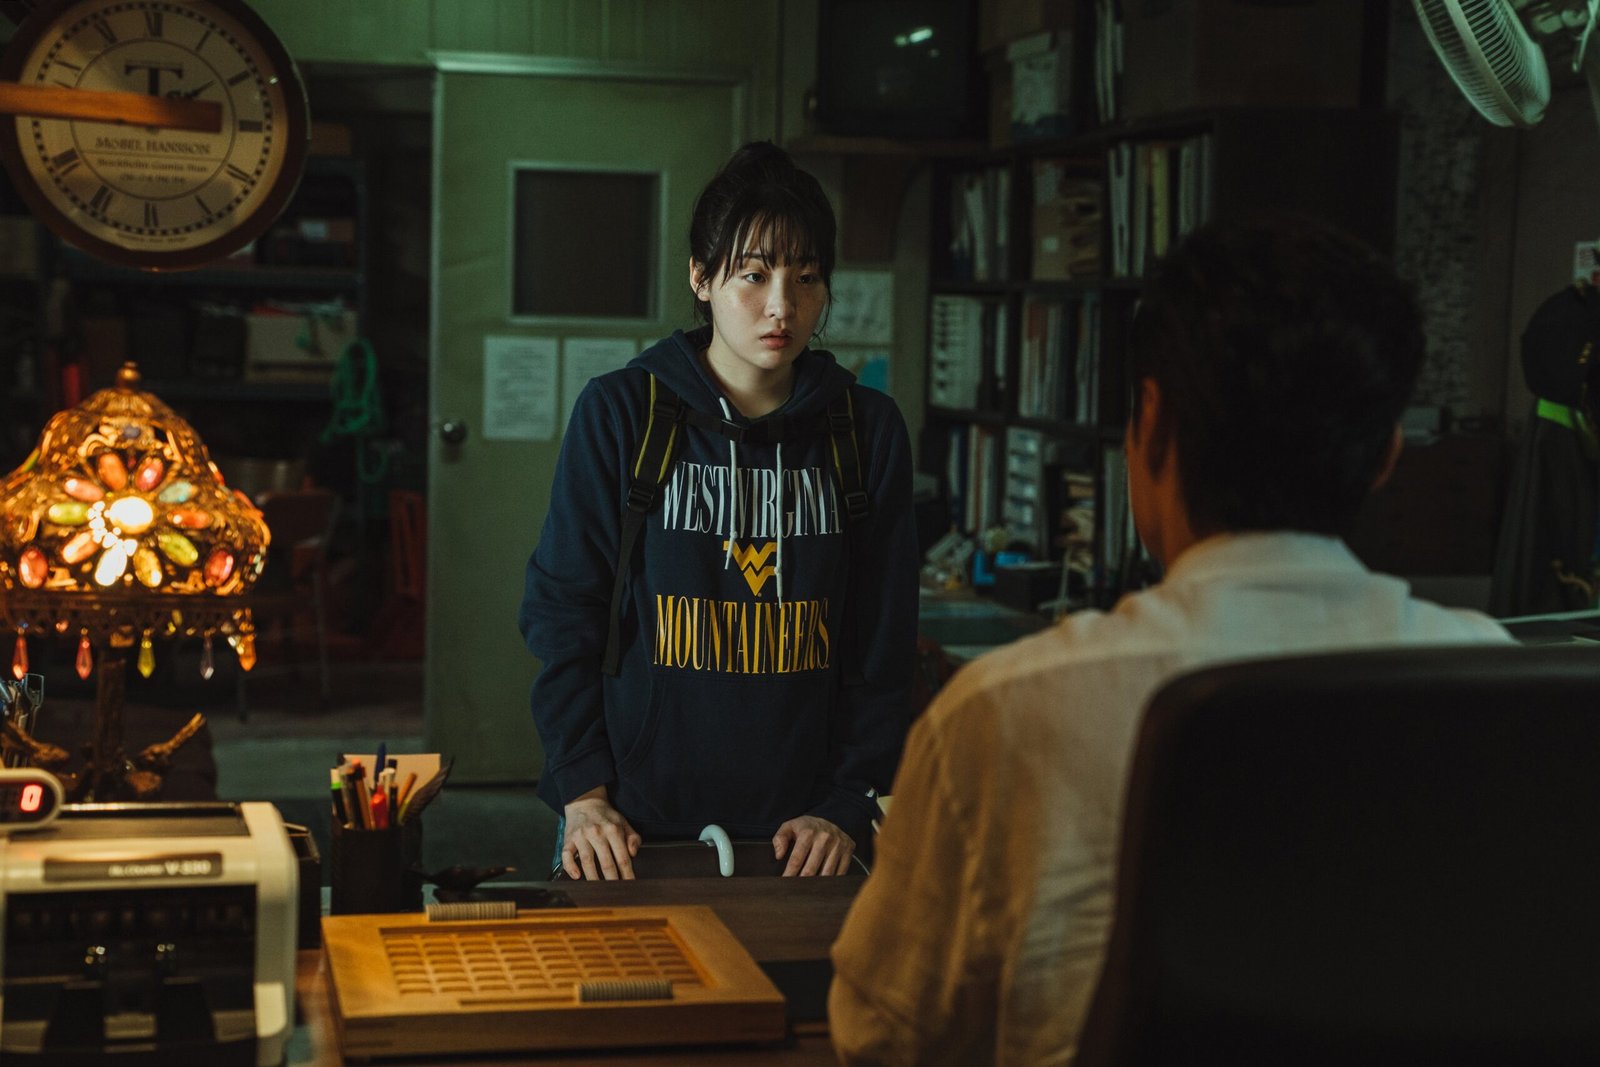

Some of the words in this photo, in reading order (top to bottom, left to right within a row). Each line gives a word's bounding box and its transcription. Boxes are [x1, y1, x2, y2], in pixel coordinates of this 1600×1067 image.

[663, 461, 731, 536] WEST
[731, 466, 843, 539] VIRGINIA
[653, 594, 831, 675] MOUNTAINEERS
[20, 784, 43, 812] 0
